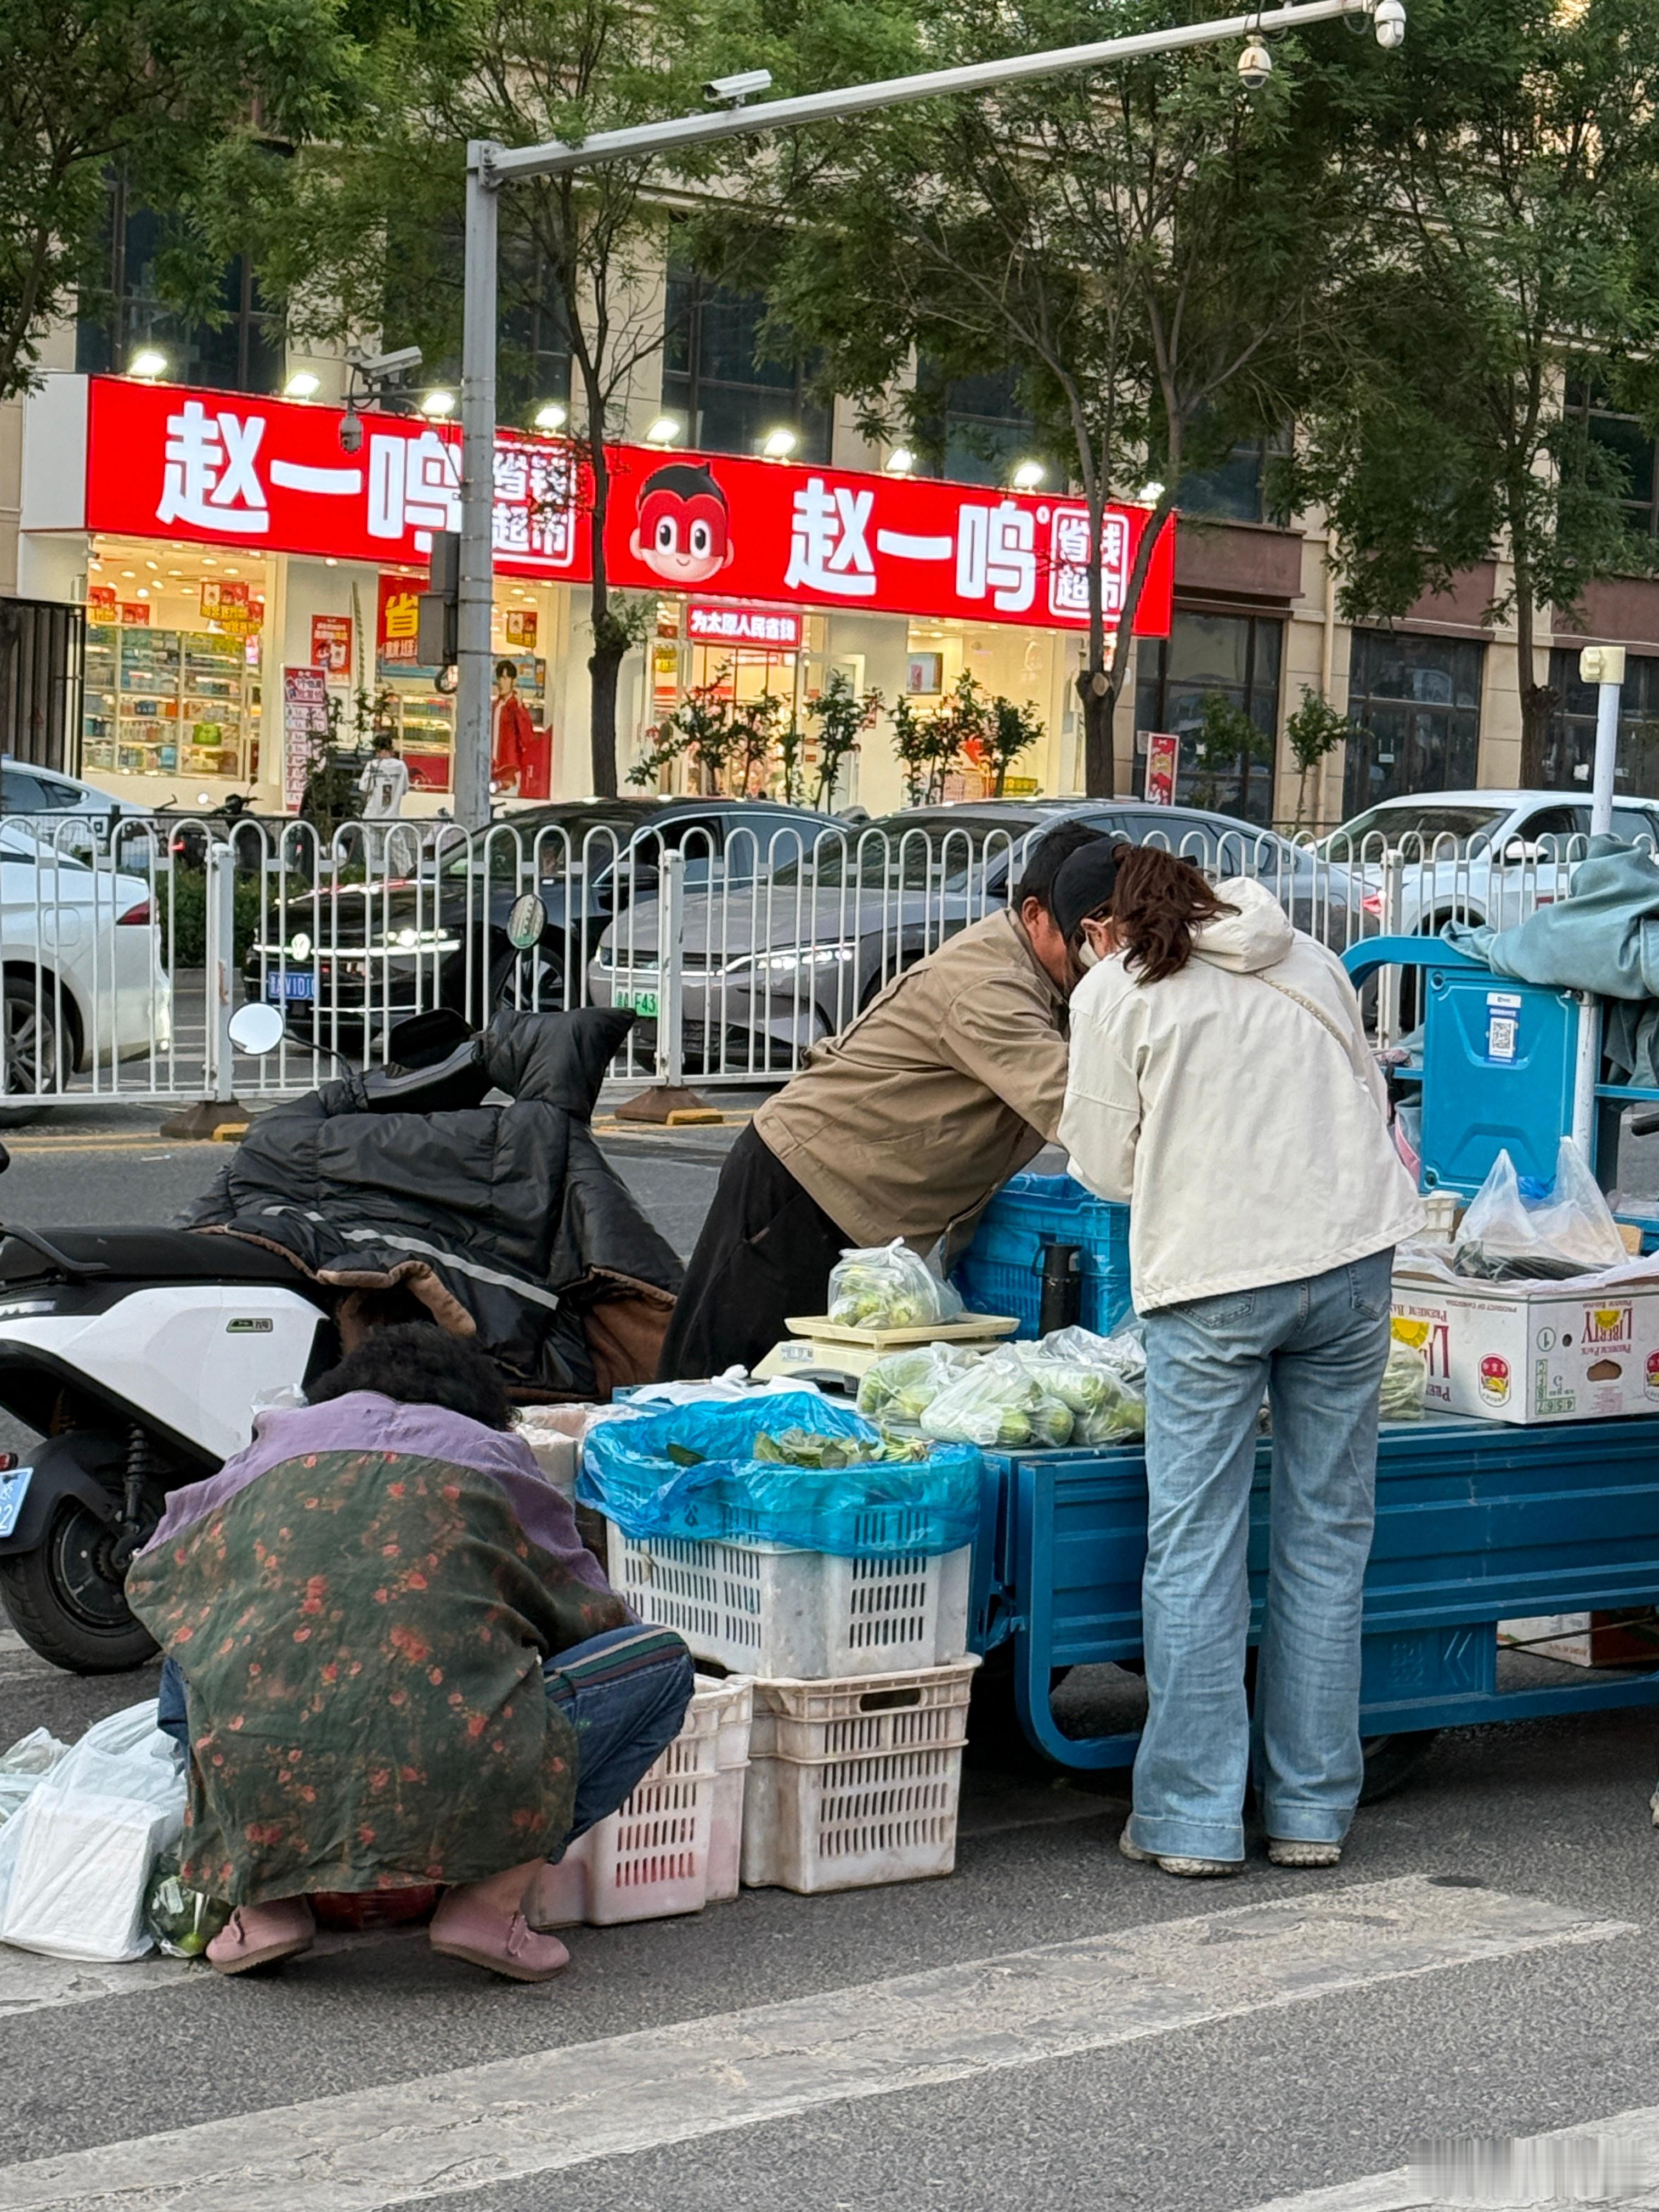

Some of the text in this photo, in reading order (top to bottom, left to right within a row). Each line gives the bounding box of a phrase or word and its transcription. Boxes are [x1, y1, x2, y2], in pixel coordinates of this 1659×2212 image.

[156, 400, 461, 554] 赵一鸣
[784, 477, 1036, 612] 赵一鸣
[690, 610, 795, 641] 为太原人民省钱
[1581, 1308, 1633, 1344] LIBERTY
